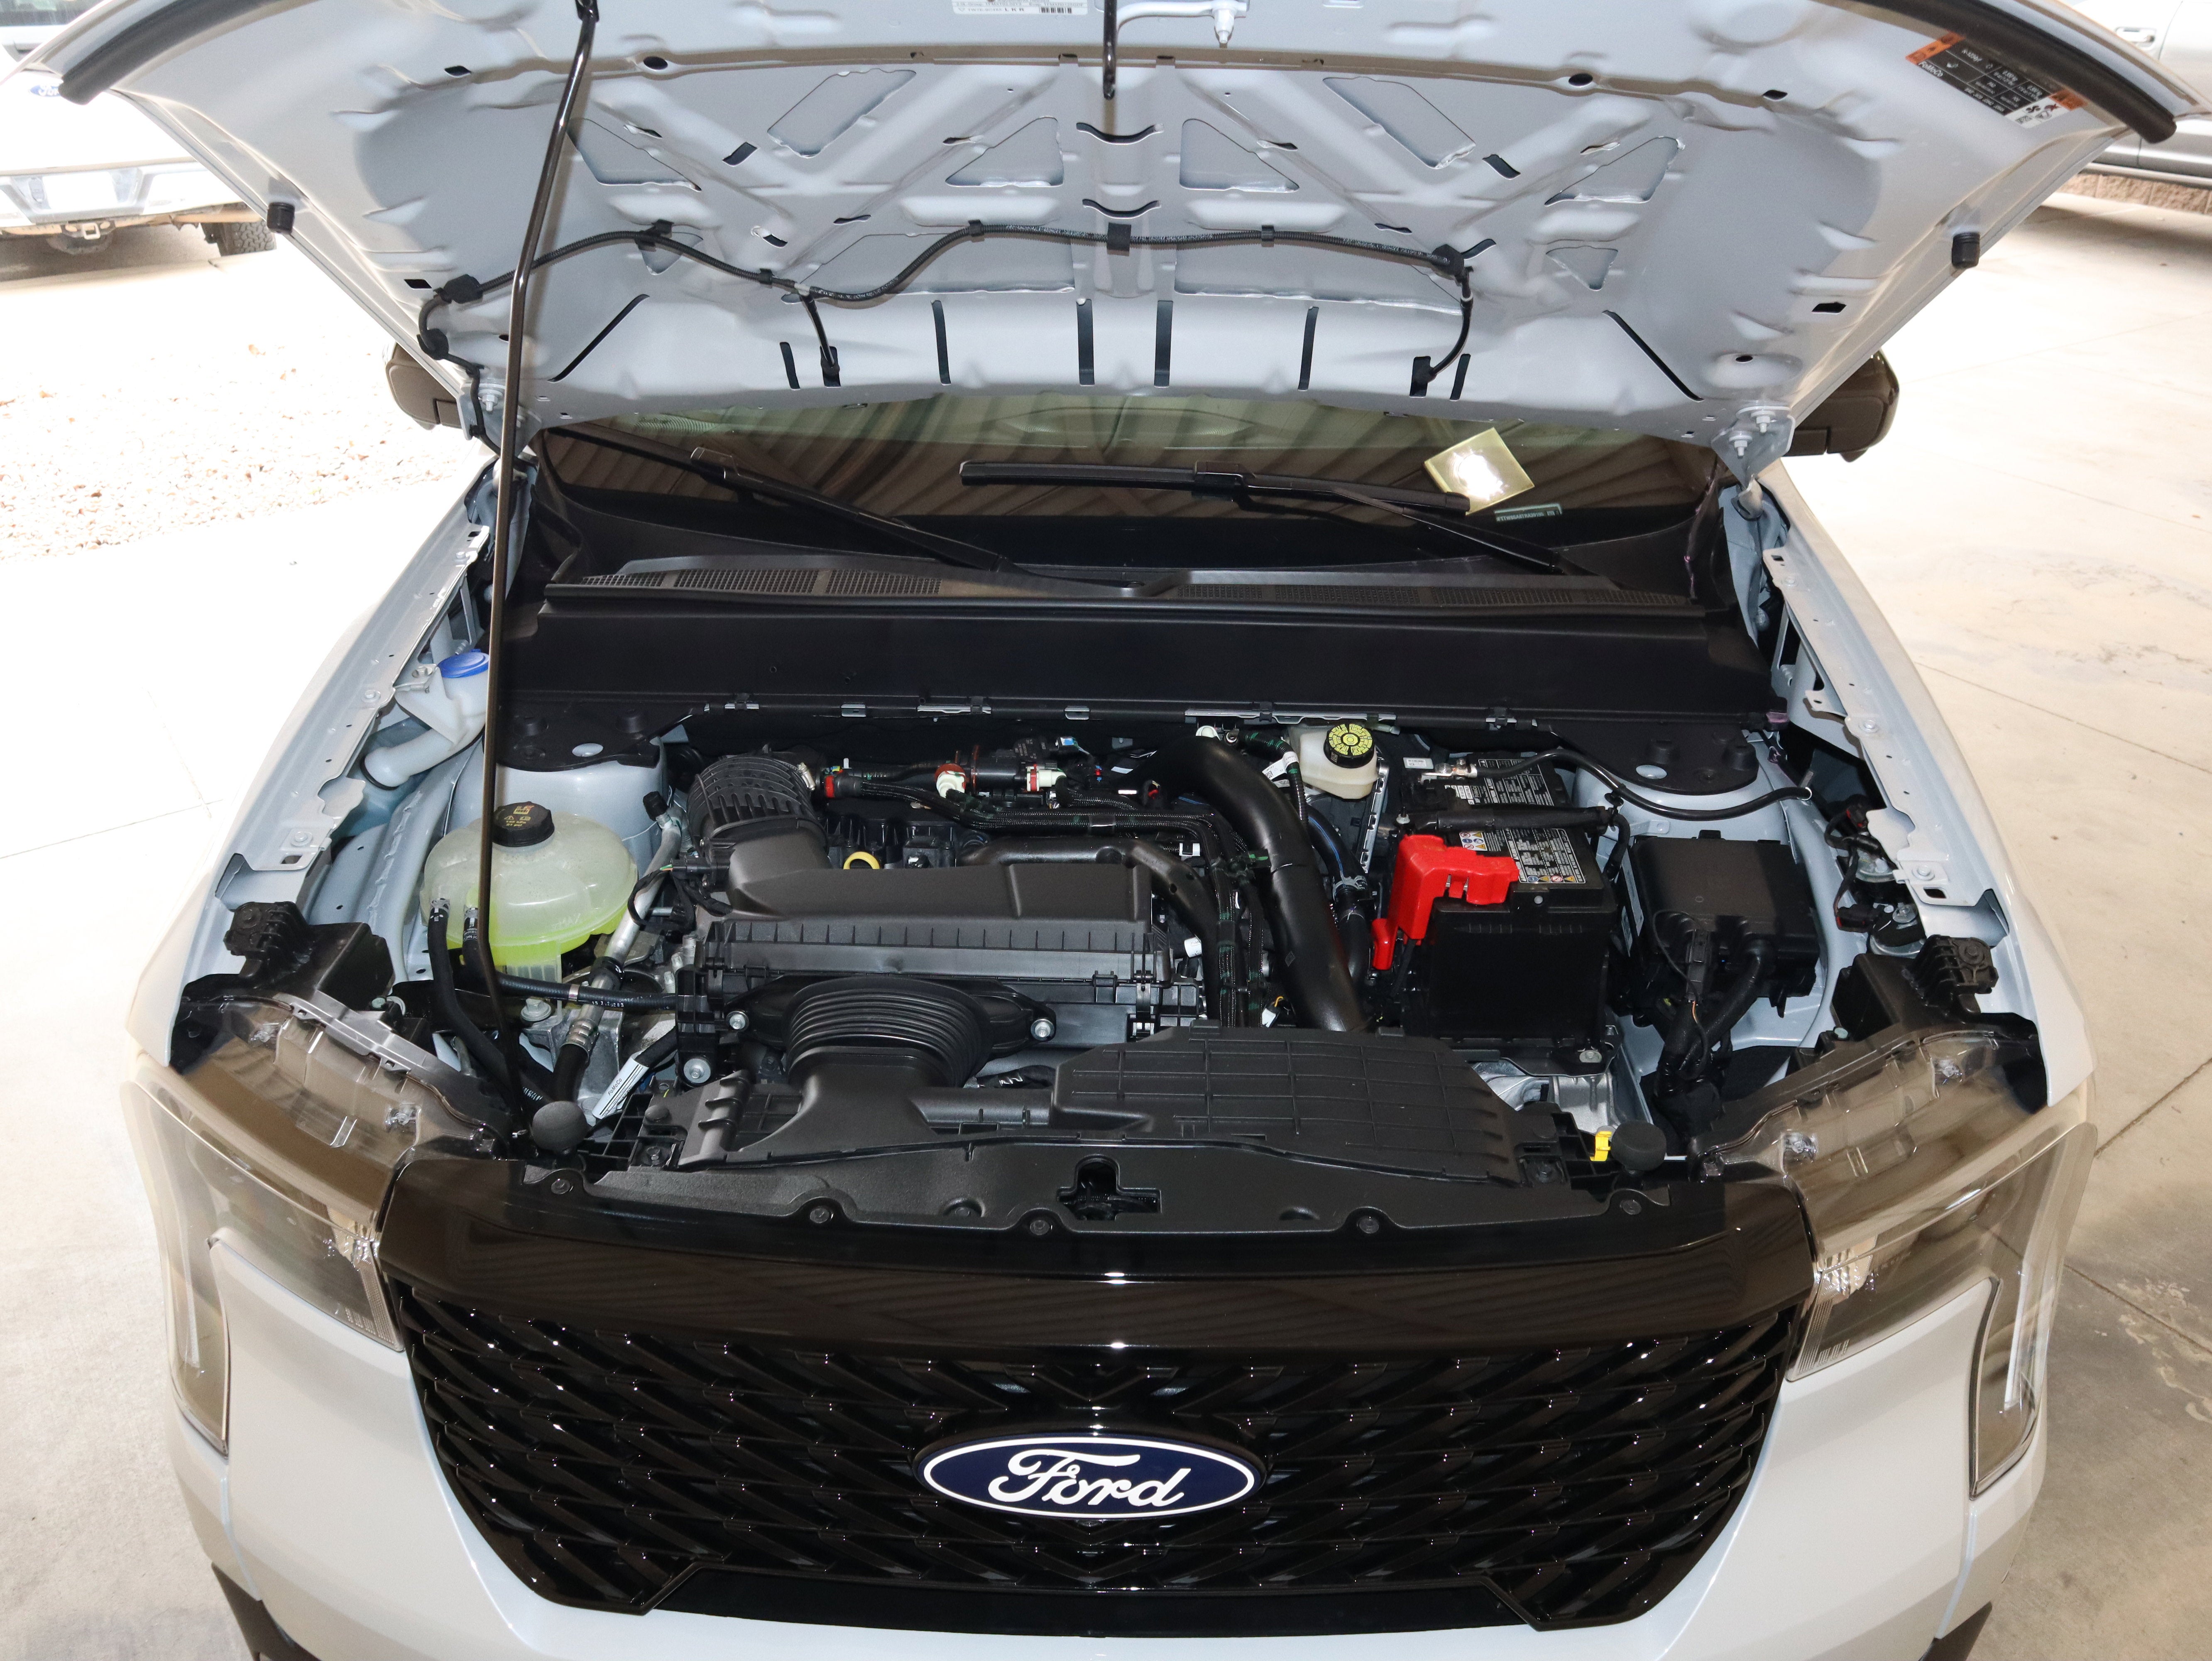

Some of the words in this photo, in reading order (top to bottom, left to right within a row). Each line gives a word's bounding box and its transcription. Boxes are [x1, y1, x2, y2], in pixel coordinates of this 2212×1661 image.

[1918, 61, 1943, 77] FoMoCo
[608, 1078, 622, 1096] FoMoCo
[988, 1449, 1192, 1507] Ford
